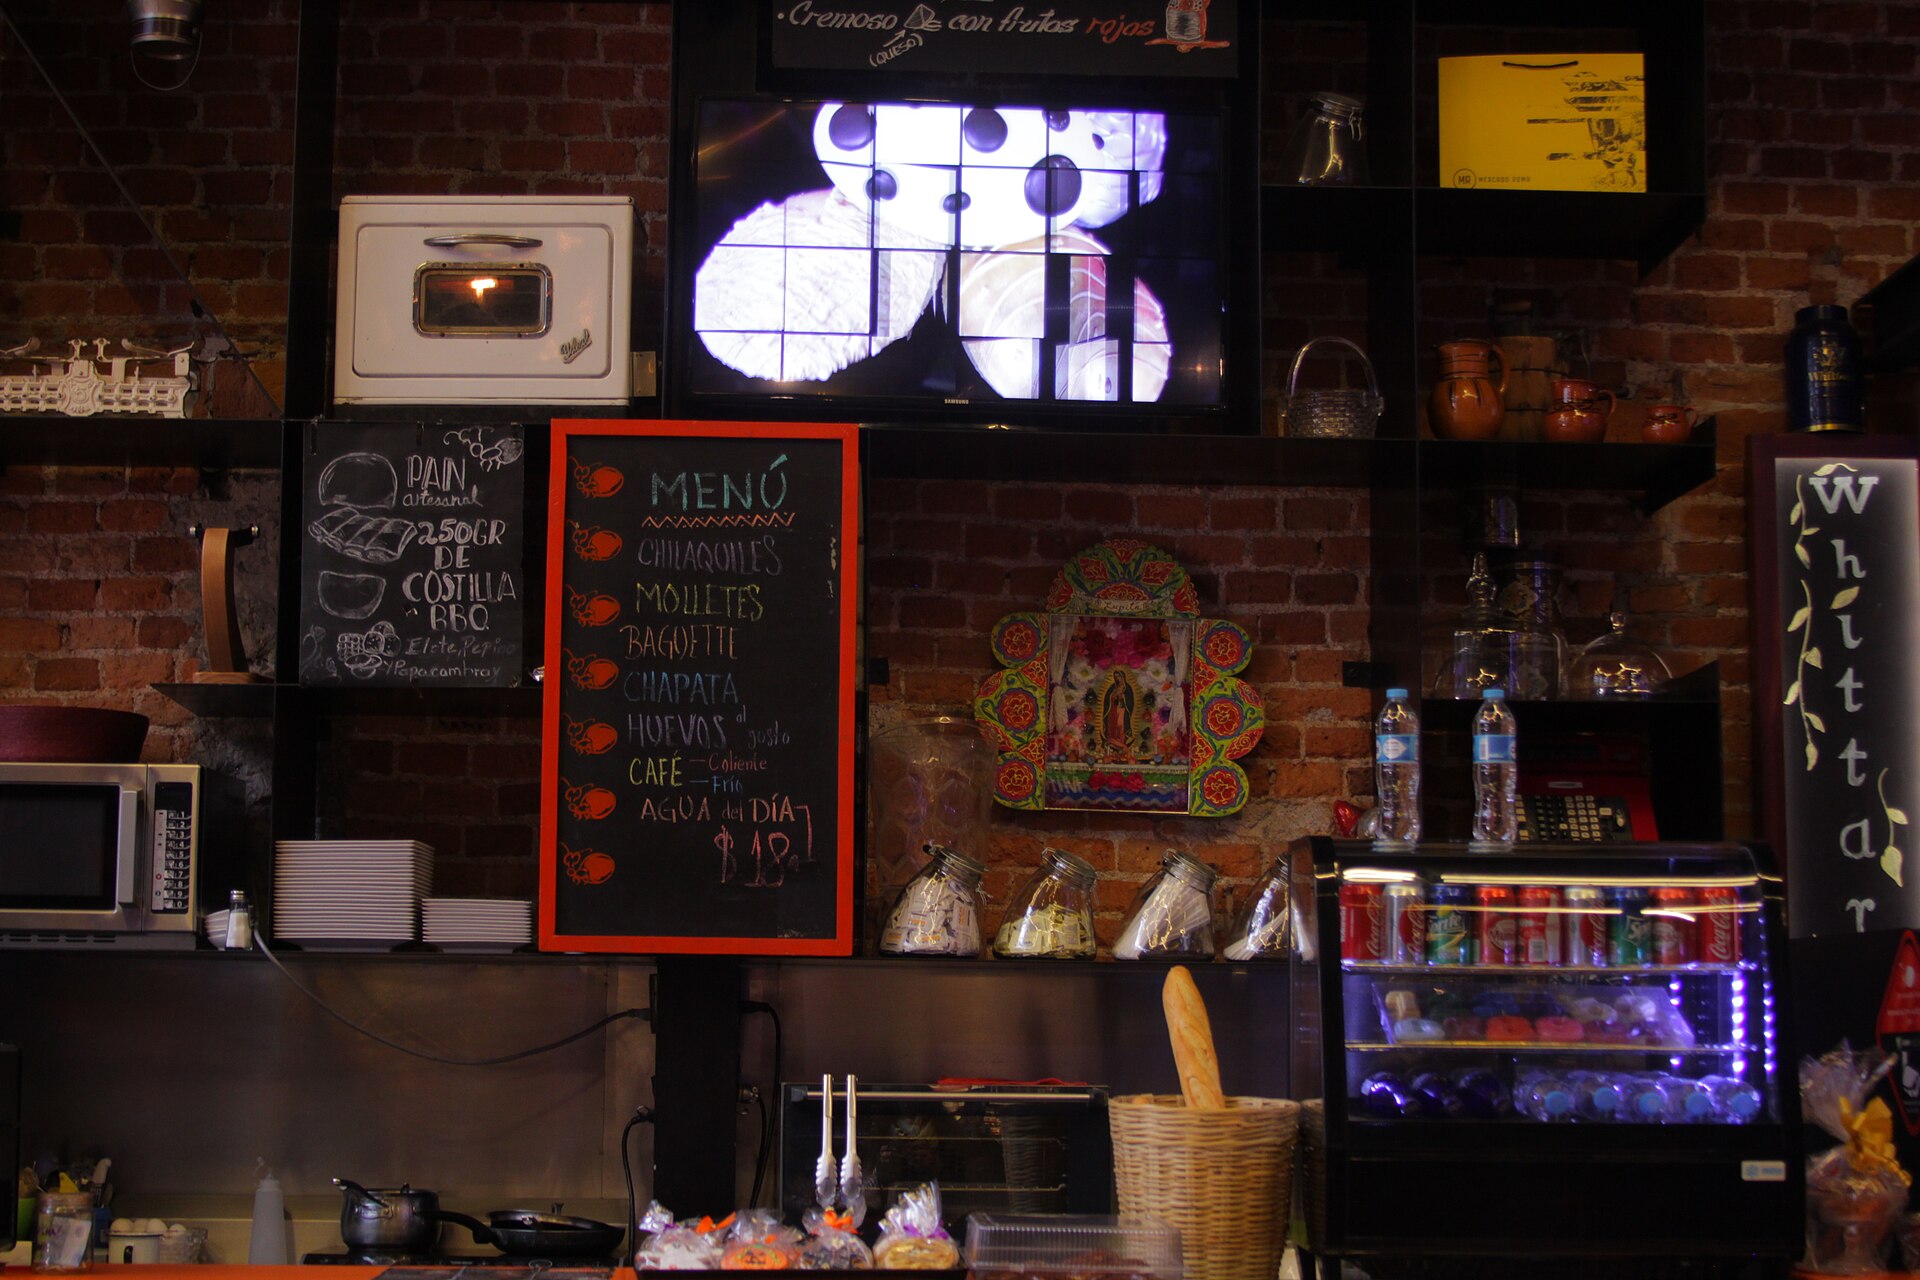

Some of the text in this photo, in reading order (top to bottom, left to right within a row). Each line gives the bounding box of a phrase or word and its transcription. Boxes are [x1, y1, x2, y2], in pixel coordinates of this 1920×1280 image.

[789, 0, 898, 31] Cremoso
[948, 14, 993, 32] con
[999, 6, 1080, 33] frutas
[869, 33, 924, 67] (QUESO)
[407, 455, 466, 491] PAN
[651, 454, 788, 511] MENÚ
[403, 485, 484, 507] artesanal
[417, 519, 506, 546] 250GR
[434, 546, 470, 570] DE
[638, 535, 783, 576] CHILAQUILES
[402, 570, 517, 604] COSTILLA
[635, 582, 764, 622] MOLLETES
[430, 604, 490, 632] BBQ
[619, 624, 739, 660] BAGUETTE
[624, 671, 739, 705] CHAPATA
[628, 713, 727, 749] HUEVOS
[629, 750, 683, 787] CAFÉ
[712, 775, 744, 794] Frío
[640, 793, 796, 823] AGUA del DÍA
